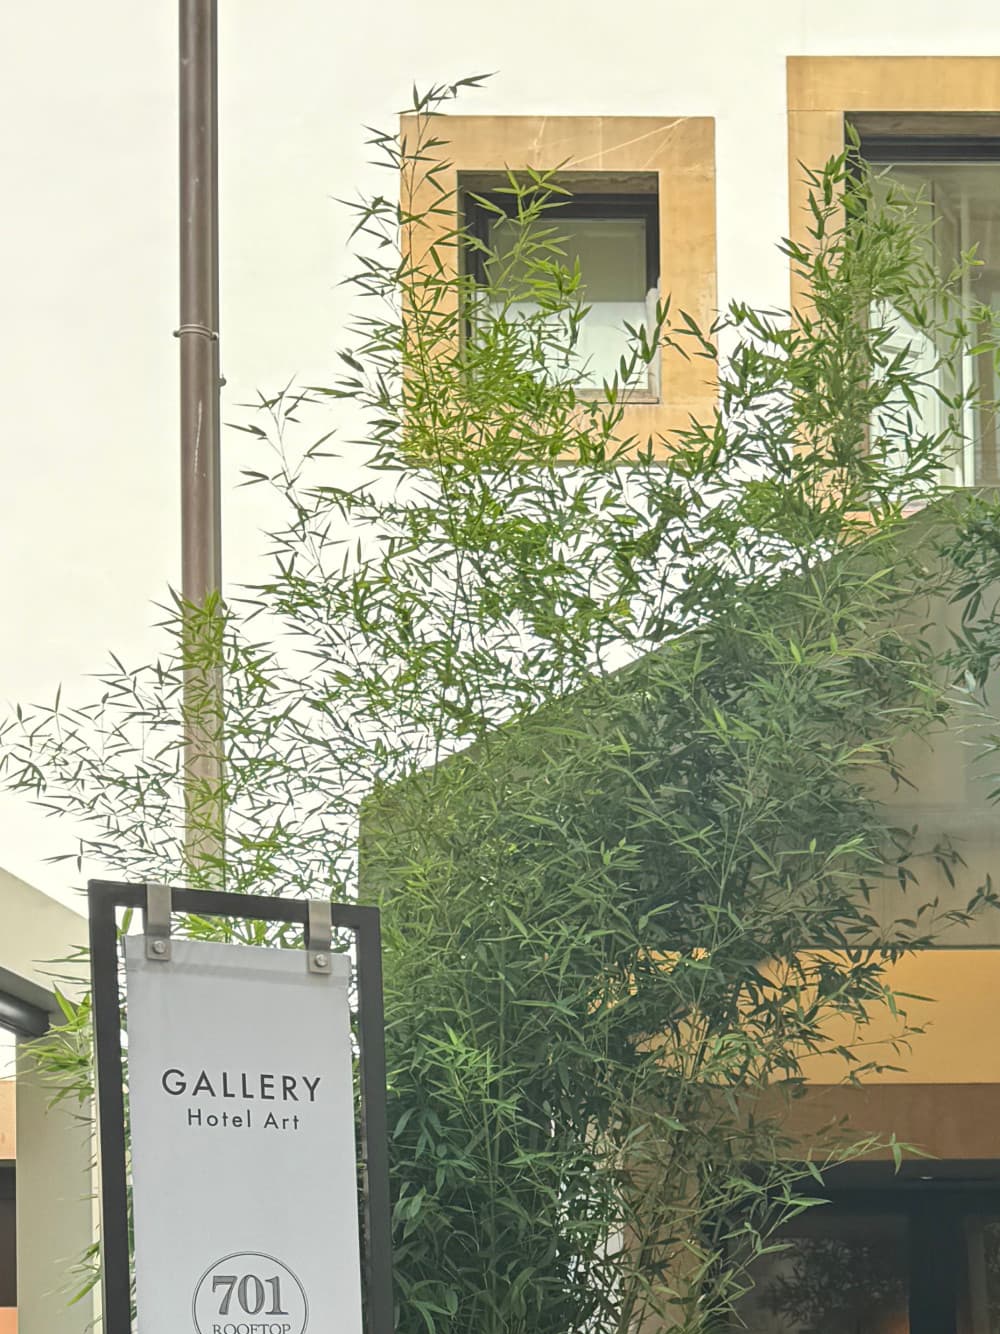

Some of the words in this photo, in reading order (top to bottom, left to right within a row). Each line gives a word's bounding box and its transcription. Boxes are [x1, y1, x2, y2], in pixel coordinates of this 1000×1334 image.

[161, 1069, 320, 1101] GALLERY
[188, 1108, 251, 1127] Hotel
[263, 1111, 299, 1129] Art
[212, 1274, 288, 1315] 701
